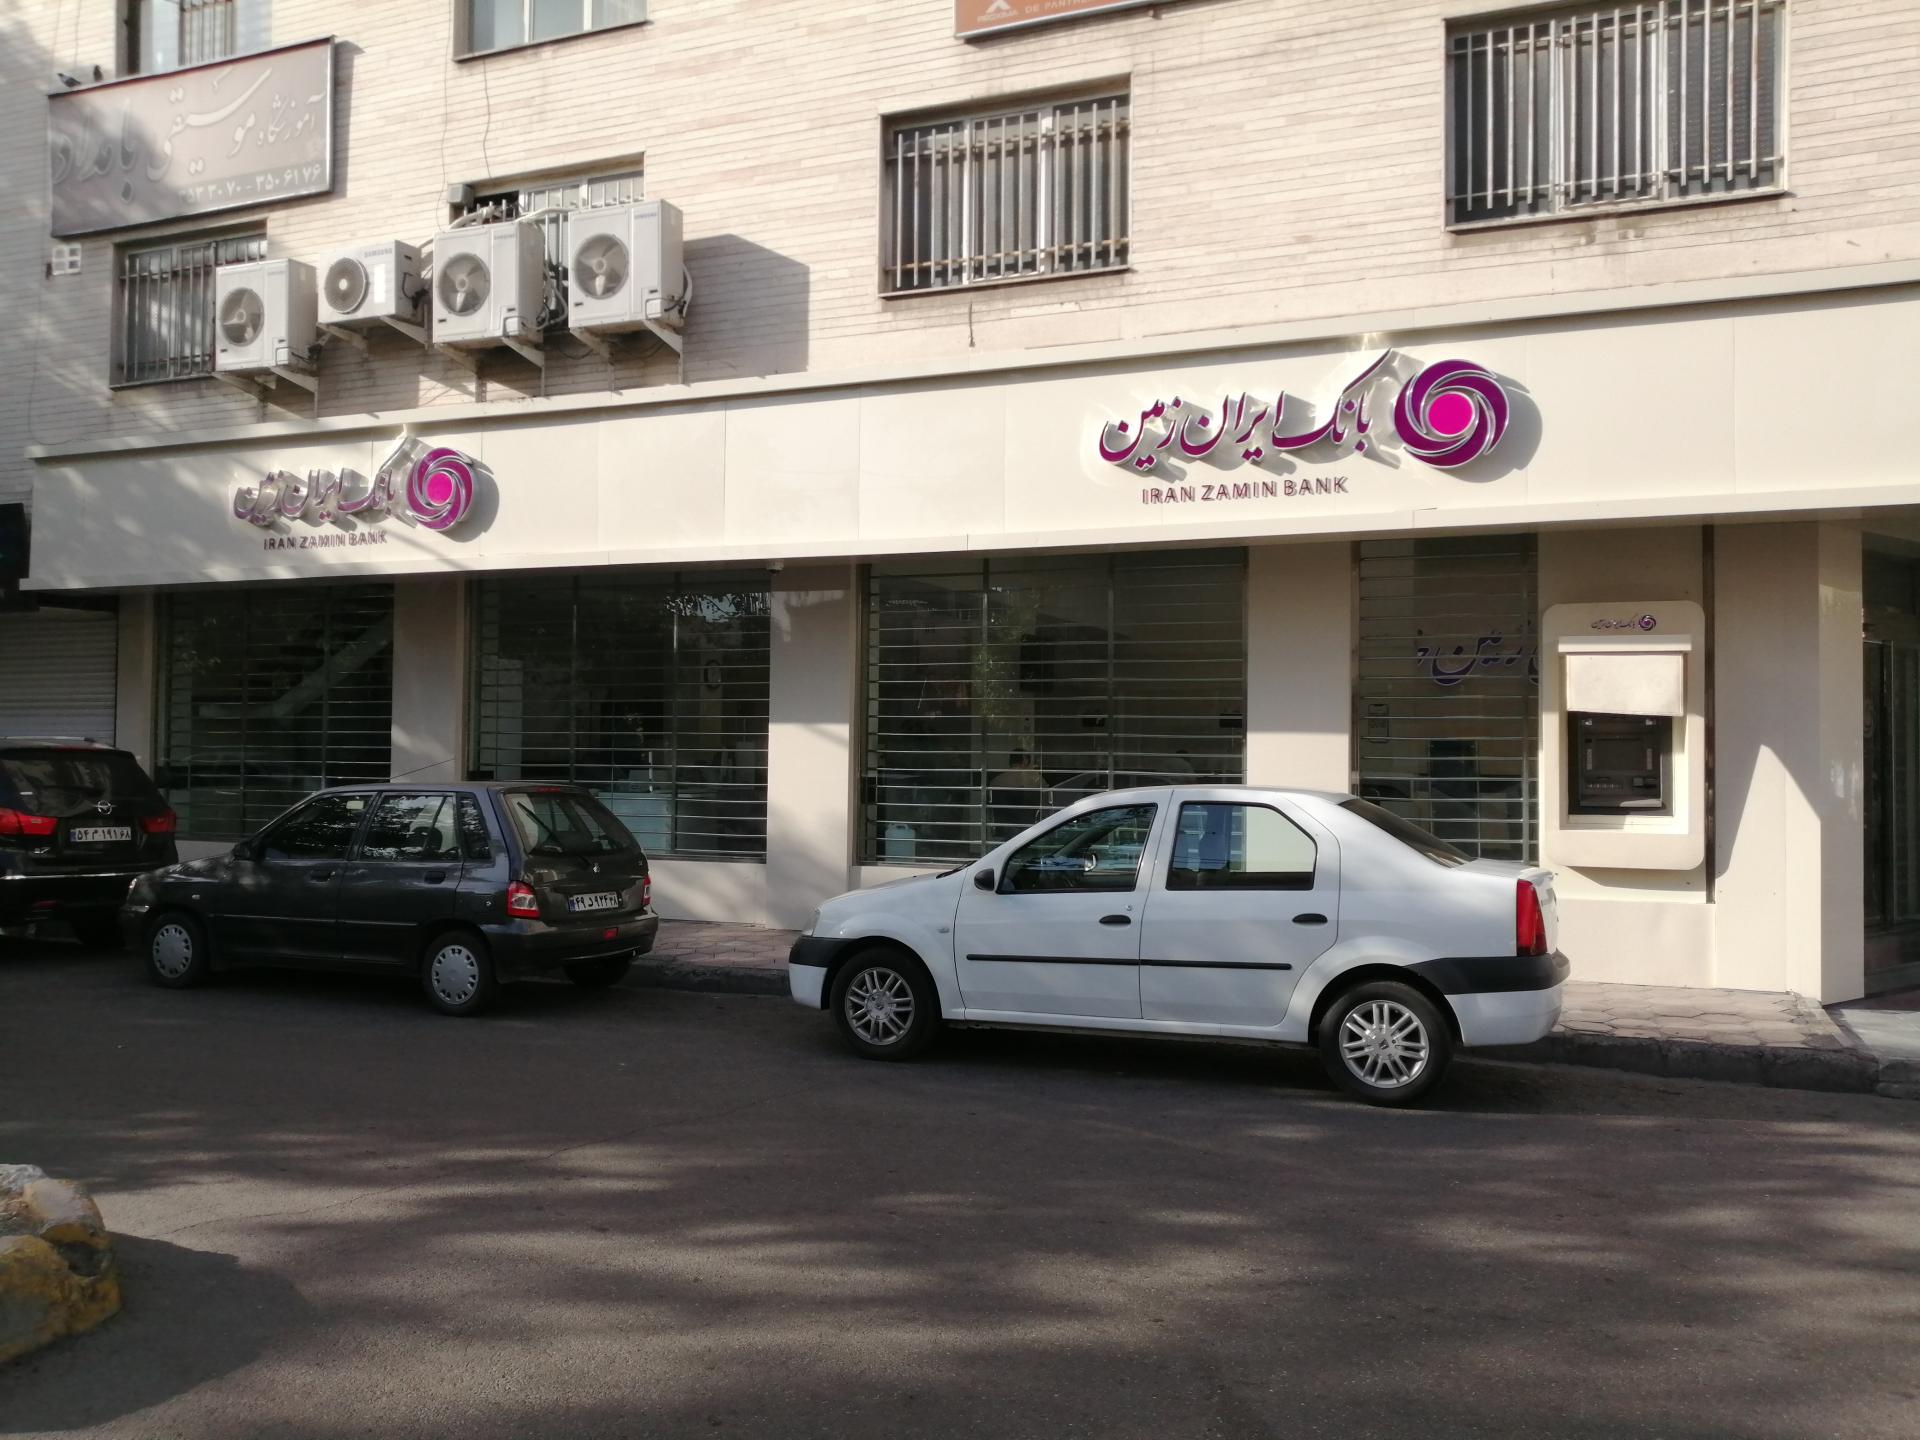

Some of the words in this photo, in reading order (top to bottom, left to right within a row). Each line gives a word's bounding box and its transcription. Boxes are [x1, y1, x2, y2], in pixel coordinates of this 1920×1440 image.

[48, 98, 137, 204] بامداد
[147, 67, 273, 181] موسیقی
[257, 91, 326, 146] آموزشگاه
[1099, 396, 1184, 471] زمین
[1180, 390, 1286, 463] ایران
[1272, 347, 1391, 455] بانک
[233, 471, 284, 526] زمین
[281, 467, 347, 522] ایران
[337, 436, 407, 516] بانک
[1142, 485, 1196, 504] IRAN
[1201, 480, 1278, 501] ZAMIN
[1283, 476, 1349, 497] BANK
[264, 537, 297, 551] IRAN
[300, 532, 347, 549] ZAMIN
[349, 529, 388, 546] BANK
